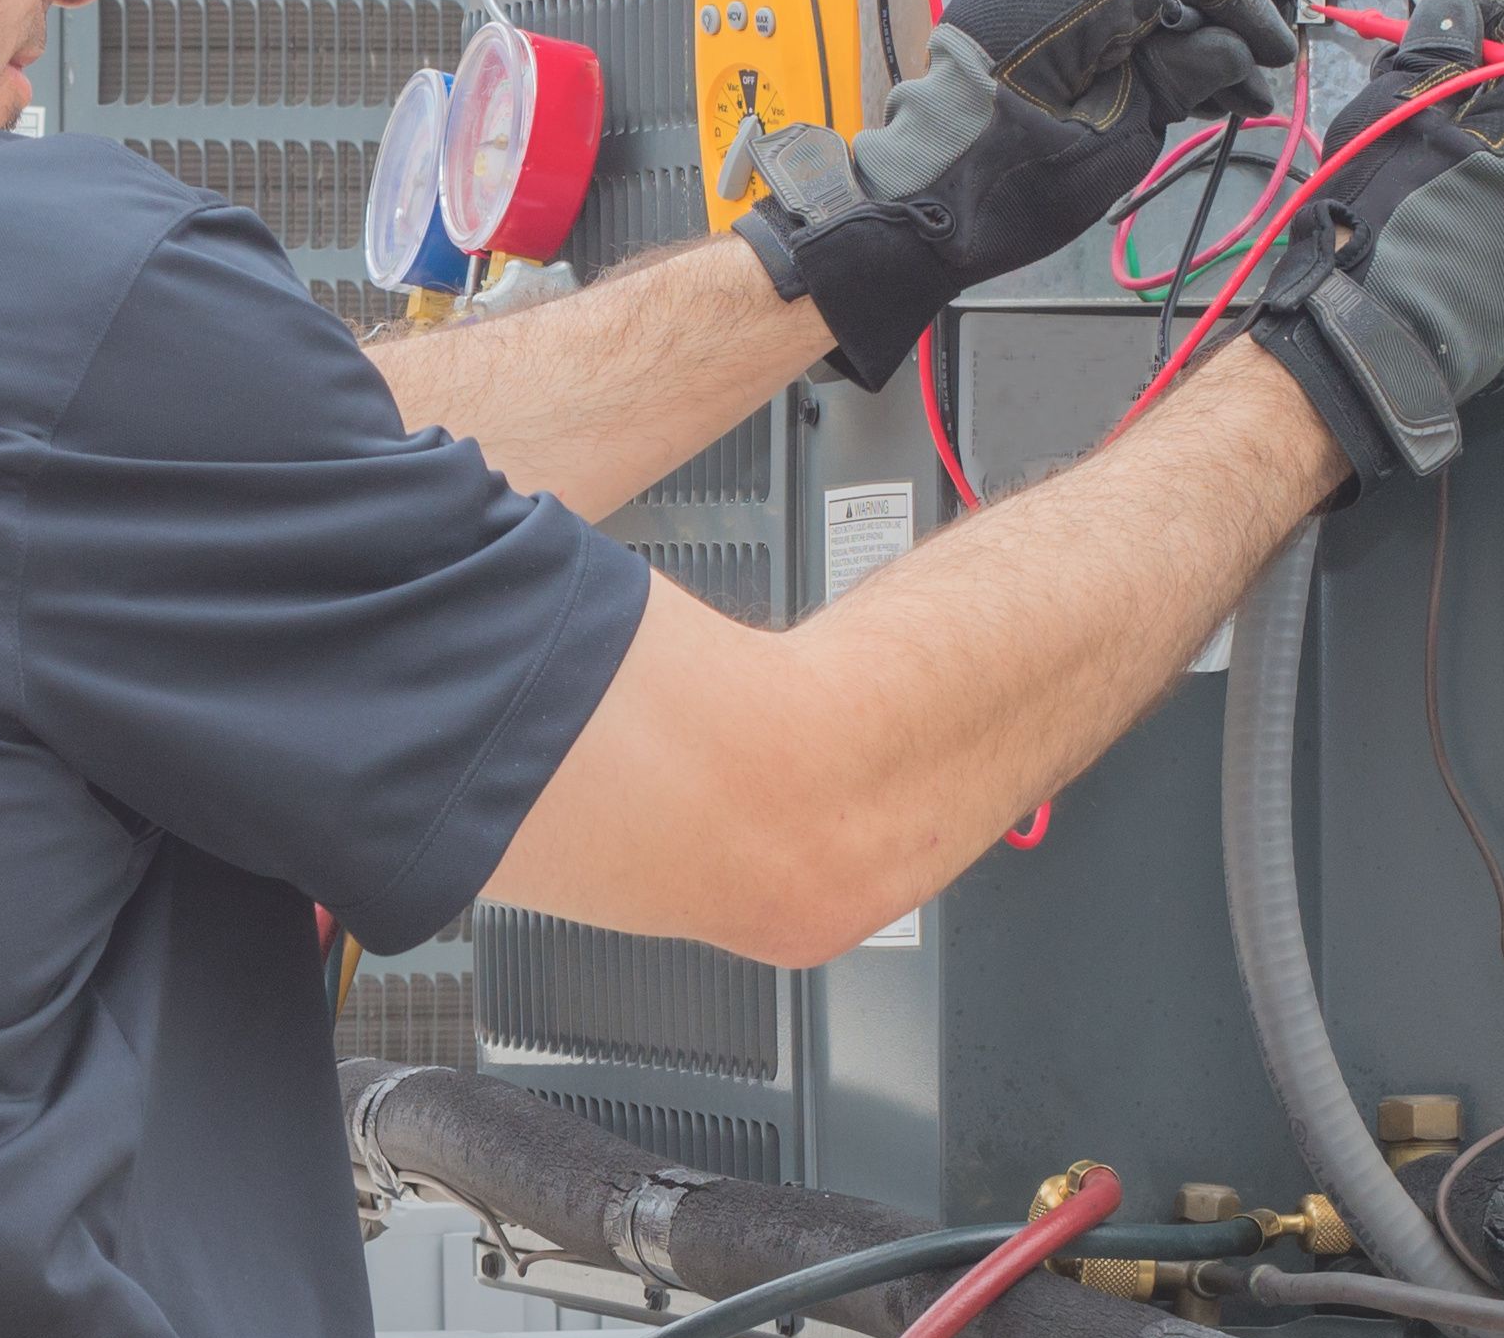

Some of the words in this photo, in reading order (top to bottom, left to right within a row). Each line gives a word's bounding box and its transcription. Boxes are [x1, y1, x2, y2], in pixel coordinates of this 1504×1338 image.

[756, 15, 769, 24] MAX
[882, 9, 894, 64] RUBBER
[742, 75, 755, 85] OFF
[717, 103, 728, 113] Hz
[854, 499, 889, 517] WARNING
